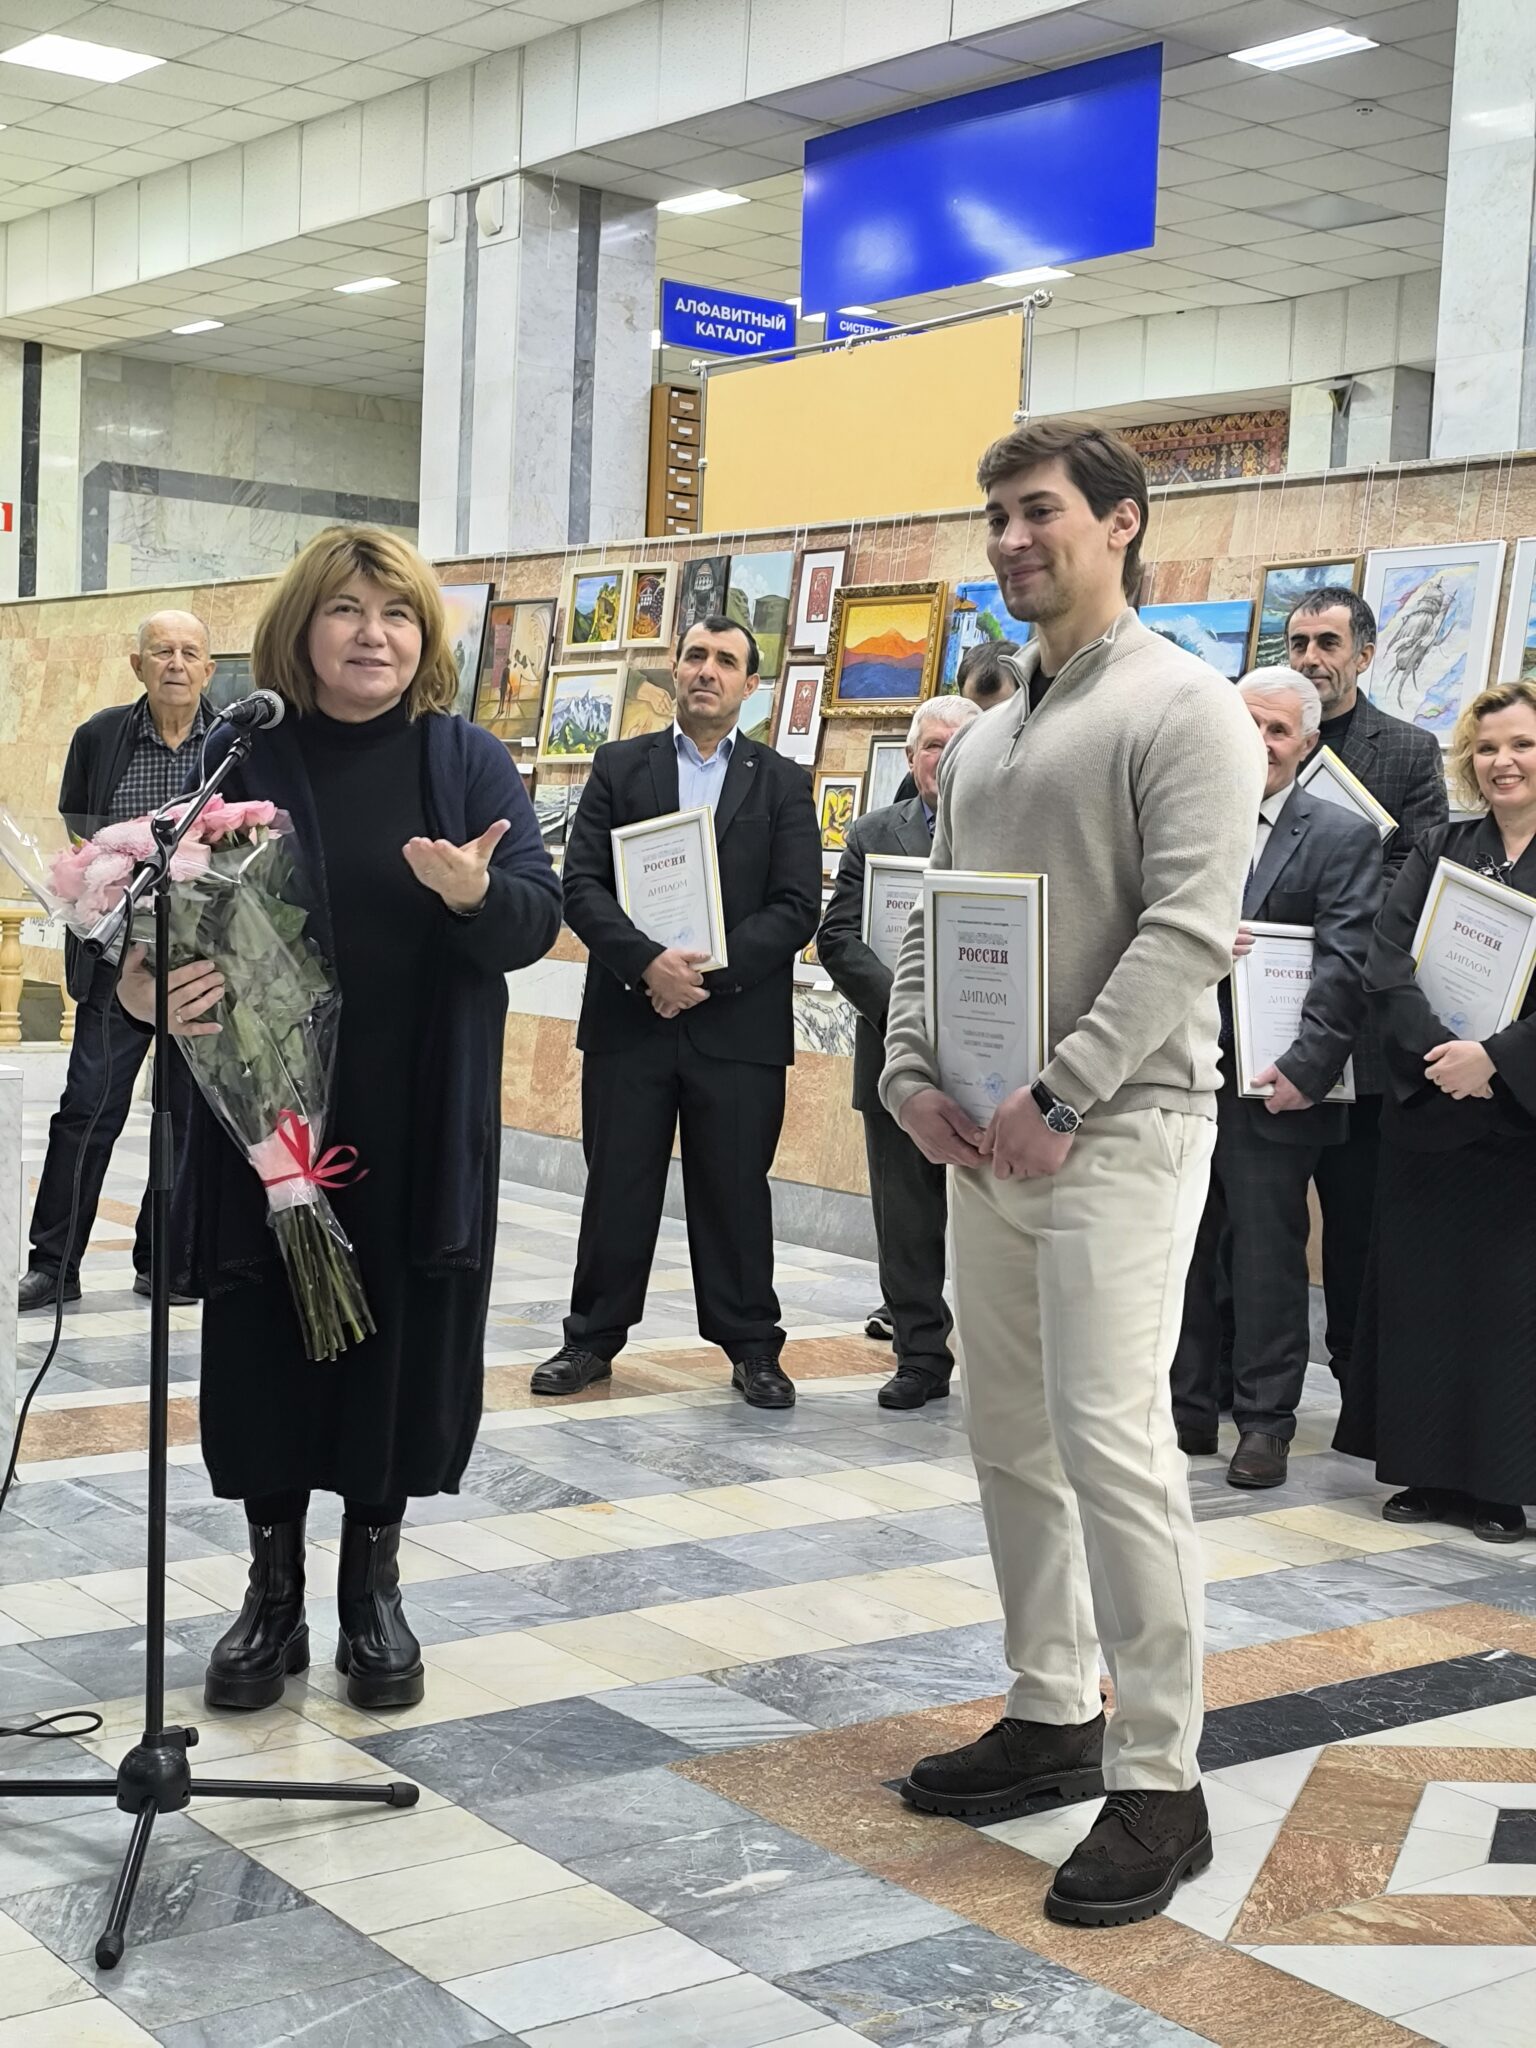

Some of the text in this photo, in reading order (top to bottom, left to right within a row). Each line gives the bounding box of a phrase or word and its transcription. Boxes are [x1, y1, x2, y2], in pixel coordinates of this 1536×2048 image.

[675, 297, 786, 331] АЛФАВИТНЫЙ
[695, 321, 765, 346] КАТАЛОГ
[643, 854, 687, 874] РОССИЯ
[647, 879, 688, 897] ДИПЛОМ
[1452, 920, 1502, 952] РОССИЯ
[958, 946, 1009, 965] РОССИЯ
[1445, 949, 1492, 978] ДИПЛОМ
[1264, 967, 1313, 980] РОССИЯ
[959, 989, 1007, 1007] ДИПЛОМ
